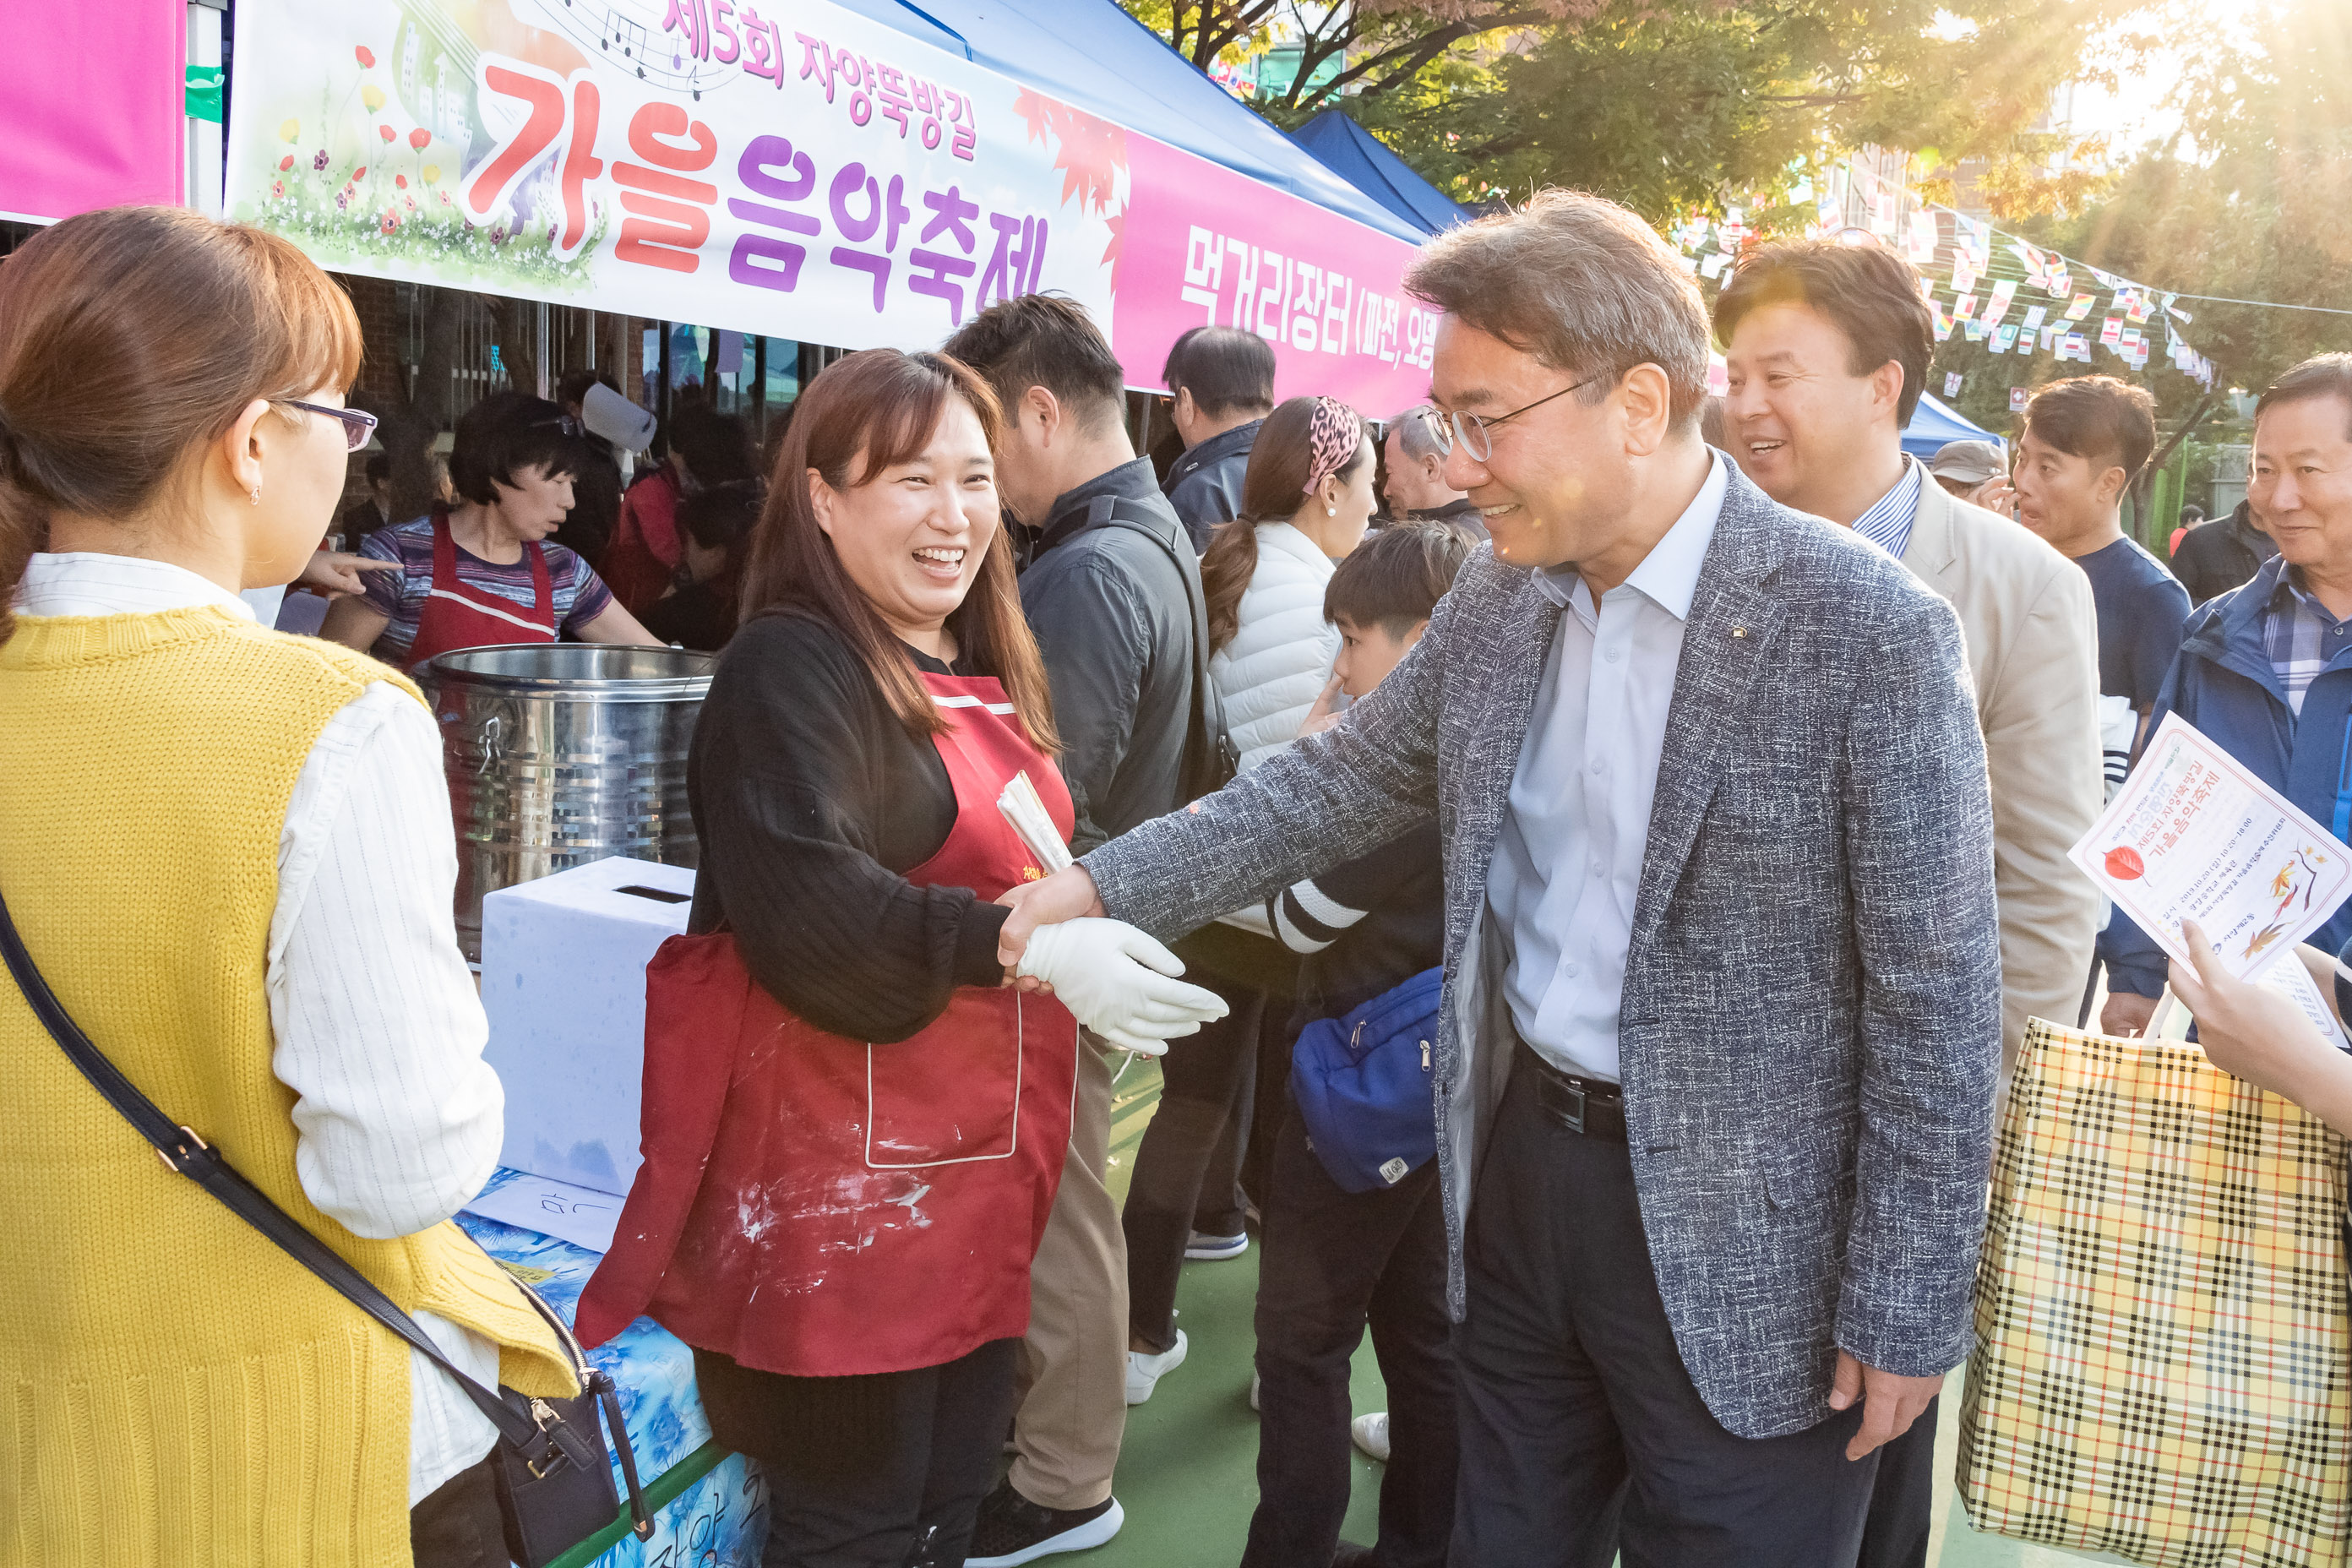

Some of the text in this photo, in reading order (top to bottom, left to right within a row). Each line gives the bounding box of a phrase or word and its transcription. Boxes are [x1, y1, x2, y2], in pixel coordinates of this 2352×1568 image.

[662, 0, 976, 162] 제5회 자양뚝방길
[469, 64, 1048, 328] 가을음악축제
[1181, 224, 1353, 357] 먹거리장터
[1355, 286, 1402, 372] (파전,
[2137, 818, 2164, 849] 제5회
[2161, 760, 2204, 818] 자양뚝방길
[2148, 770, 2220, 856] 가을음악축제
